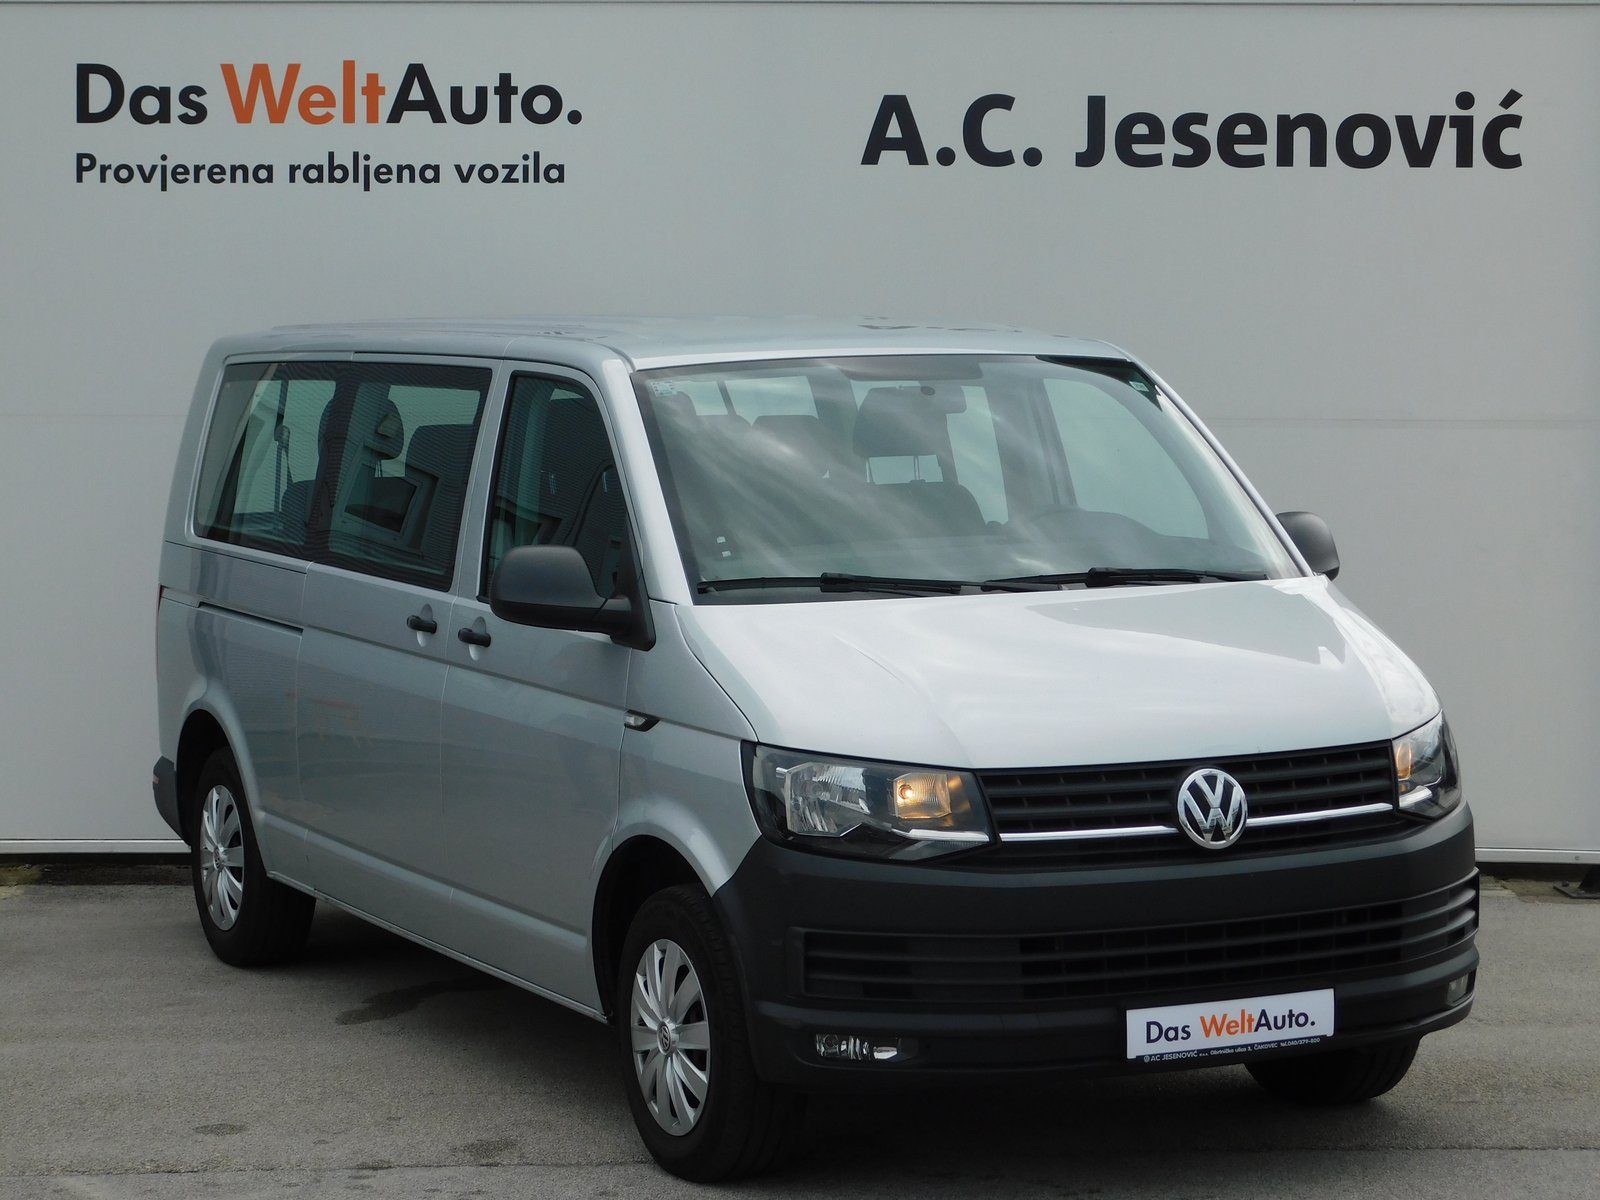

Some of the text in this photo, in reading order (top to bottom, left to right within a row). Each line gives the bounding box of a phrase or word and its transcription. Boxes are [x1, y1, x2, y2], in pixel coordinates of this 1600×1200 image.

[76, 60, 582, 125] Das WeltAuto.
[861, 89, 1523, 169] A.C. Jesenović
[76, 151, 564, 191] Provjerena rabljena vozila
[1145, 1008, 1316, 1044] Das WeltAuto.
